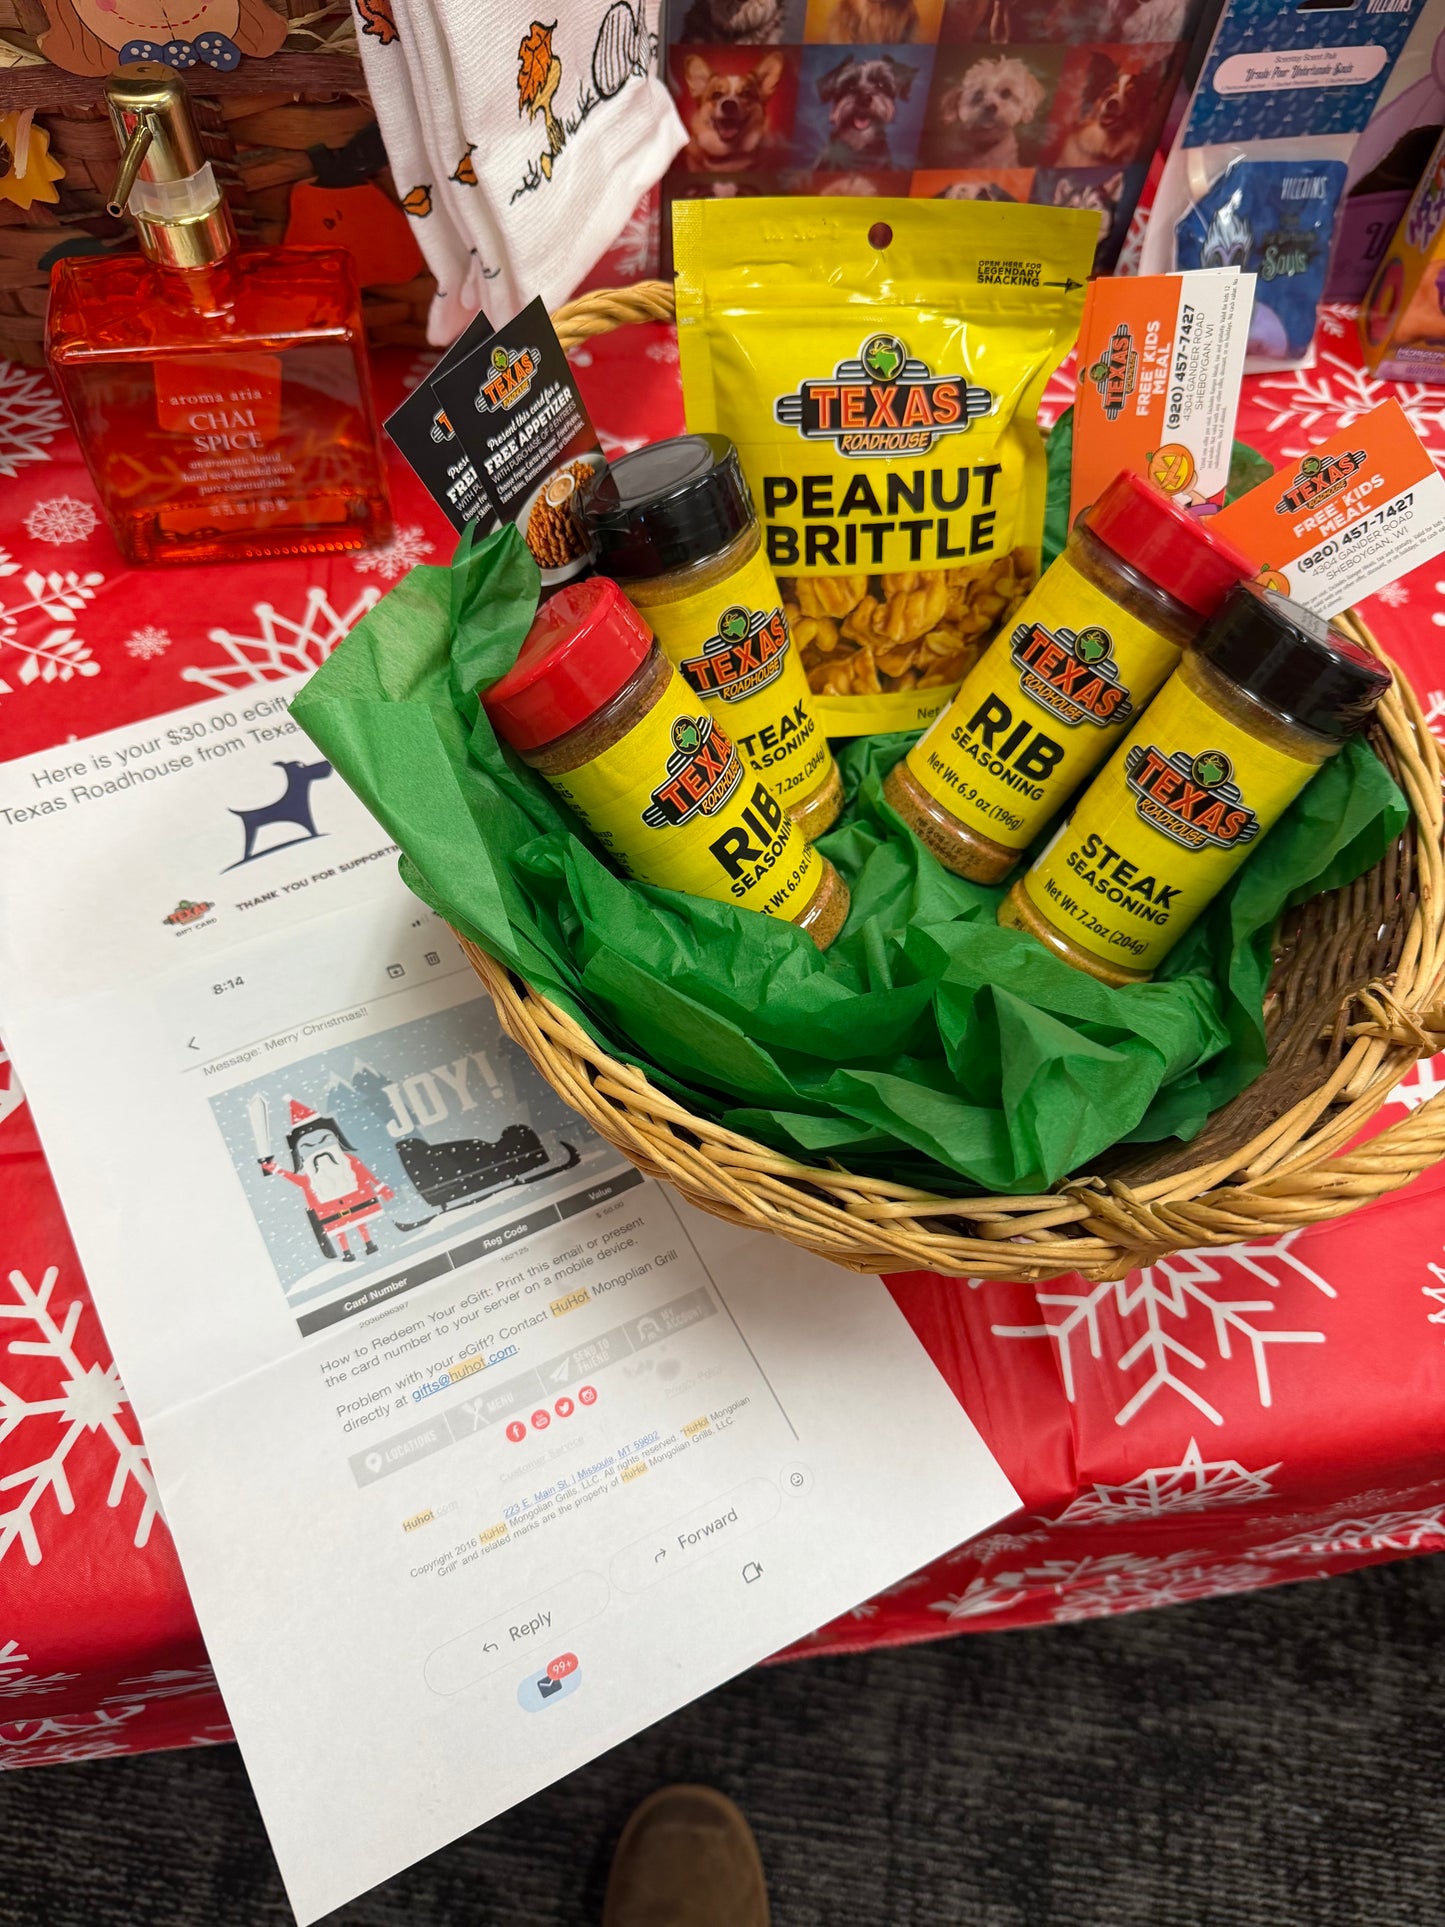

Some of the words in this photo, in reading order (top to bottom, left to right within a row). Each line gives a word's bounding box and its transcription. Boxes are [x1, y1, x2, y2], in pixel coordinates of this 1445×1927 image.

[977, 275, 1039, 287] SNACKING
[978, 267, 1040, 277] LEGENDARY
[1143, 321, 1159, 362] KIDS
[1193, 312, 1204, 343] ROAD
[484, 353, 534, 405] TEXAS
[1106, 336, 1129, 405] TEXAS
[1136, 371, 1153, 415] FREE
[1152, 342, 1170, 394] MEAL
[1166, 386, 1184, 429] (920)
[1175, 304, 1194, 381] 457-7427
[1186, 346, 1200, 391] GANDER
[1194, 340, 1212, 409] SHEBOYGAN,
[1205, 324, 1214, 338] WI
[170, 392, 224, 406] aroma
[230, 388, 262, 401] aria
[188, 409, 256, 430] CHAI
[810, 384, 961, 429] TEXAS
[1183, 394, 1193, 421] 4304
[194, 432, 264, 452] SPICE
[483, 438, 519, 476] FREE
[519, 387, 572, 446] APPETIZER
[509, 436, 541, 469] PURCHASE
[553, 402, 575, 427] ENTREES
[840, 430, 930, 450] ROADHOUSE
[763, 464, 1001, 519] PEANUT
[1285, 456, 1354, 505] TEXAS
[1293, 503, 1338, 537] FREE
[1342, 474, 1384, 506] KIDS
[767, 511, 997, 567] BRITTLE
[1298, 541, 1338, 572] (920)
[1342, 492, 1413, 544] 457-7427
[1312, 557, 1337, 576] 4304
[1338, 530, 1382, 560] GANDER
[1381, 510, 1413, 533] ROAD
[1319, 501, 1371, 536] MEAL
[1326, 537, 1393, 580] SHEBOYGAN,
[1392, 526, 1408, 538] WI
[688, 616, 786, 691] TEXAS
[723, 657, 780, 698] ROADHOUSE
[1022, 631, 1123, 717] TEXAS
[917, 706, 938, 719] Net
[1022, 673, 1084, 721] ROADHOUSE
[32, 763, 87, 788] Here
[91, 755, 111, 769] is
[115, 738, 160, 765] your
[166, 712, 237, 745] $30.00
[243, 696, 291, 721] eGift
[738, 698, 808, 756] TEAK
[967, 693, 1065, 782] RIB
[0, 797, 67, 824] Texas
[70, 755, 193, 803] Roadhouse
[197, 738, 245, 761] from
[659, 719, 731, 815] TEXAS
[702, 760, 741, 814] ROADHOUSE
[775, 772, 804, 794] 7.2oz
[804, 745, 825, 777] (204g)
[951, 726, 1044, 801] SEASONING
[927, 751, 944, 773] Net
[943, 766, 959, 785] Wt
[957, 783, 977, 800] 6.9
[975, 798, 991, 811] oz
[989, 805, 1024, 831] (196g)
[1139, 754, 1247, 840] TEXAS
[709, 782, 783, 881] RIB
[1137, 797, 1208, 846] ROADHOUSE
[236, 891, 278, 910] THANK
[282, 879, 308, 893] YOU
[311, 869, 335, 882] FOR
[769, 889, 788, 907] Wt
[787, 871, 800, 891] 6.9
[799, 859, 808, 874] oz
[1066, 852, 1170, 926] SEASONING
[1081, 833, 1182, 910] STEAK
[1044, 878, 1061, 901] Net
[1060, 894, 1078, 913] Wt
[1078, 909, 1110, 936] 7.2oz
[1109, 930, 1149, 956] (204g)
[213, 976, 245, 996] 8:14
[203, 1049, 258, 1075] Message:
[264, 1033, 298, 1050] Merry
[302, 1007, 369, 1035] Christmas!!
[383, 1050, 505, 1139] JOY!
[588, 1187, 611, 1200] Value
[483, 1236, 502, 1248] Reg
[503, 1225, 527, 1239] Code
[320, 1354, 349, 1373] How
[354, 1347, 368, 1357] to
[371, 1320, 425, 1349] Redeem
[427, 1305, 455, 1322] Your
[460, 1288, 493, 1308] eGift:
[495, 1272, 524, 1291] Print
[527, 1262, 550, 1276] this
[553, 1244, 584, 1264] email
[587, 1238, 597, 1248] or
[602, 1217, 644, 1243] present
[325, 1373, 347, 1387] the
[351, 1355, 380, 1375] card
[384, 1332, 431, 1360] number
[435, 1325, 449, 1335] to
[453, 1309, 479, 1330] your
[484, 1290, 520, 1313] server
[524, 1282, 540, 1294] on
[554, 1257, 594, 1280] mobile
[597, 1238, 638, 1259] device.
[344, 1294, 368, 1311] Card
[369, 1278, 407, 1300] Number
[336, 1386, 391, 1417] Problem
[395, 1370, 423, 1389] with
[426, 1355, 453, 1377] your
[458, 1334, 494, 1359] eGift?
[499, 1310, 548, 1339] Contact
[550, 1290, 590, 1315] HuHot
[592, 1258, 653, 1295] Mongolian
[654, 1249, 678, 1265] Grill
[343, 1404, 389, 1432] directly
[395, 1395, 408, 1408] at
[412, 1344, 518, 1402] gifts@huhot.com.
[485, 1390, 516, 1413] MENU
[383, 1428, 439, 1464] LOCATIONS
[410, 1551, 453, 1577] Copyright
[454, 1538, 477, 1555] 2016
[479, 1523, 507, 1542] HuHot
[509, 1500, 553, 1527] Mongolian
[555, 1488, 577, 1502] Grills,
[578, 1475, 602, 1490] LLC.
[604, 1466, 615, 1478] All
[617, 1455, 639, 1470] rights
[641, 1434, 676, 1457] reserved.
[710, 1397, 750, 1420] Mongolian
[501, 1502, 522, 1519] 223
[532, 1483, 557, 1503] Main
[615, 1443, 634, 1460] MT
[632, 1429, 661, 1451] 59802
[677, 1508, 739, 1549] Forward
[437, 1560, 457, 1576] Grill"
[509, 1611, 552, 1641] Reply
[552, 1660, 572, 1675] 99+
